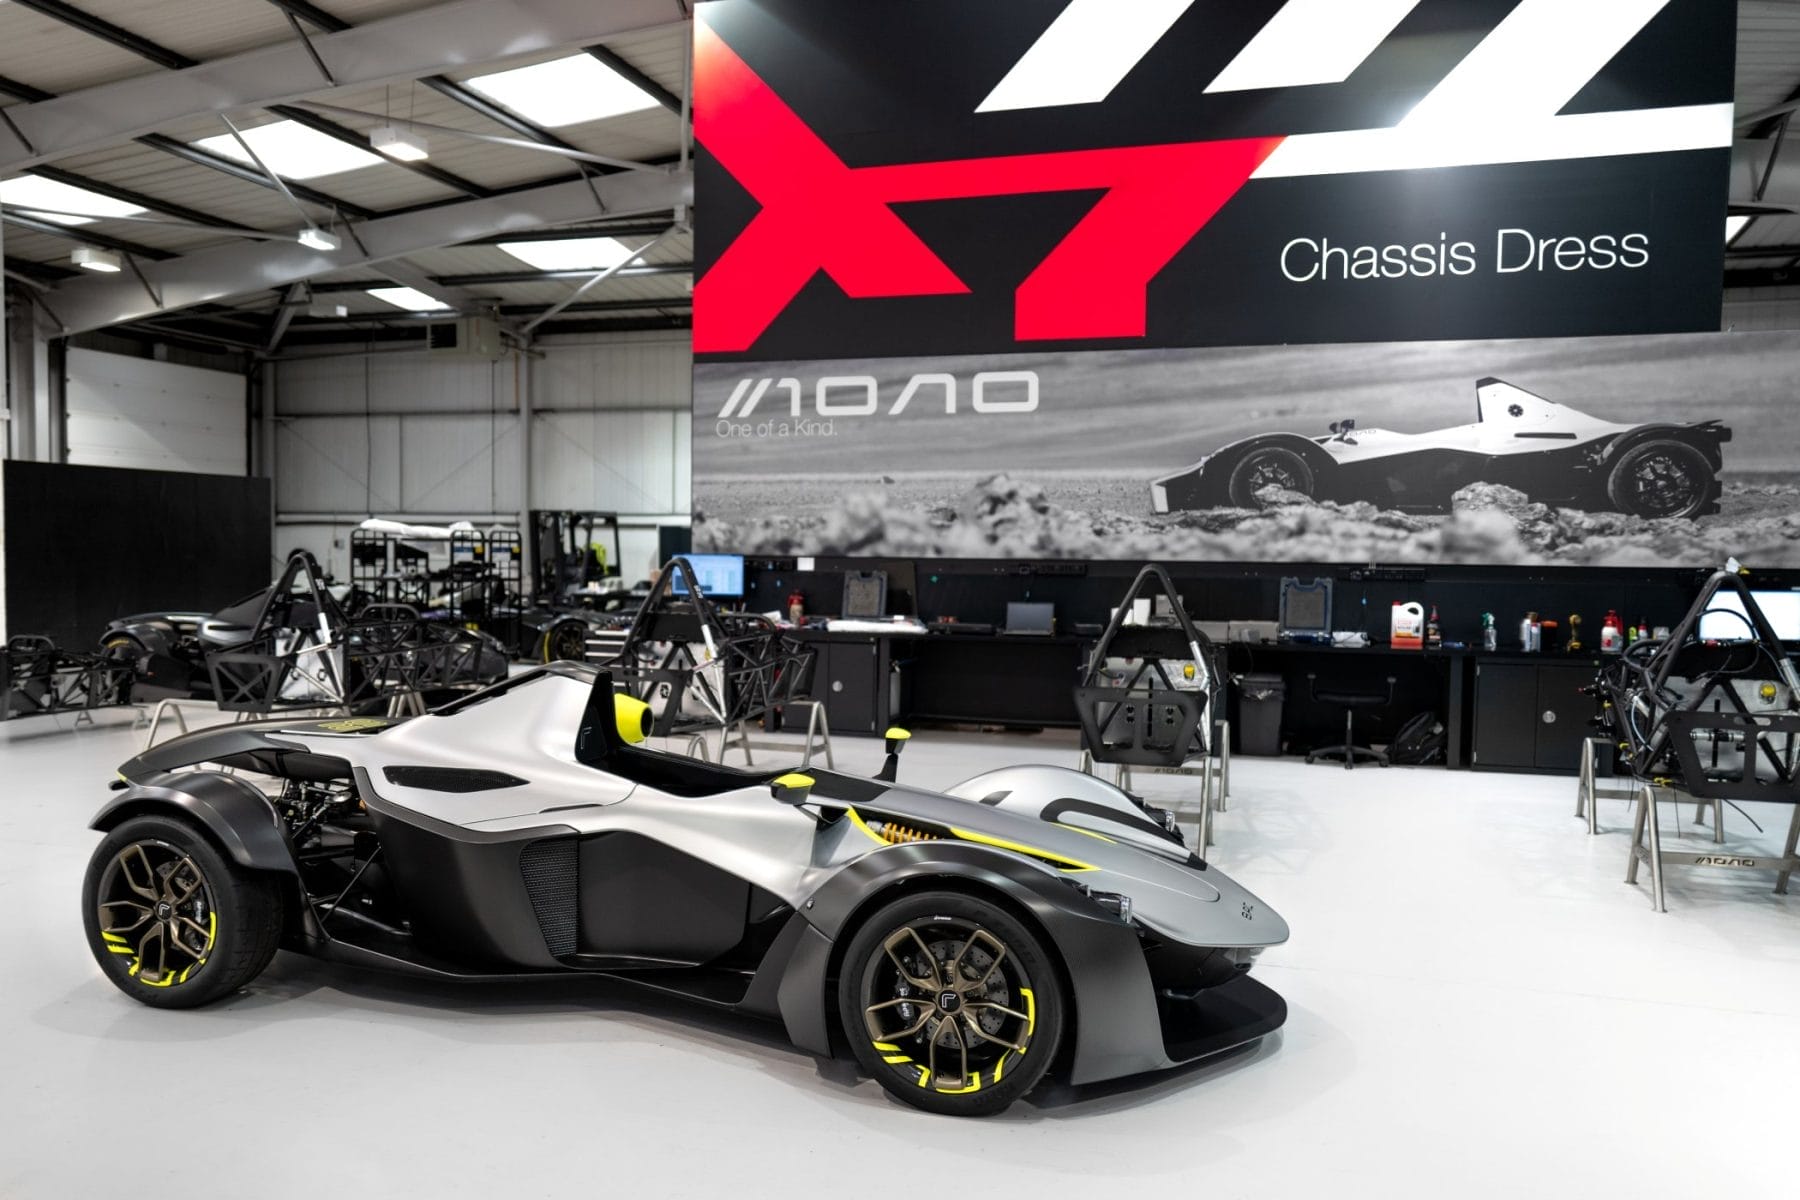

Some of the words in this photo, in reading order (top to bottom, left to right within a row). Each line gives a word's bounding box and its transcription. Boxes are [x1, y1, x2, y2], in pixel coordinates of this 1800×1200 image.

[1280, 231, 1476, 283] Chassis
[1496, 228, 1650, 273] Dress
[715, 419, 752, 438] One
[756, 418, 774, 438] of
[778, 422, 790, 437] a
[794, 418, 839, 437] Kind.
